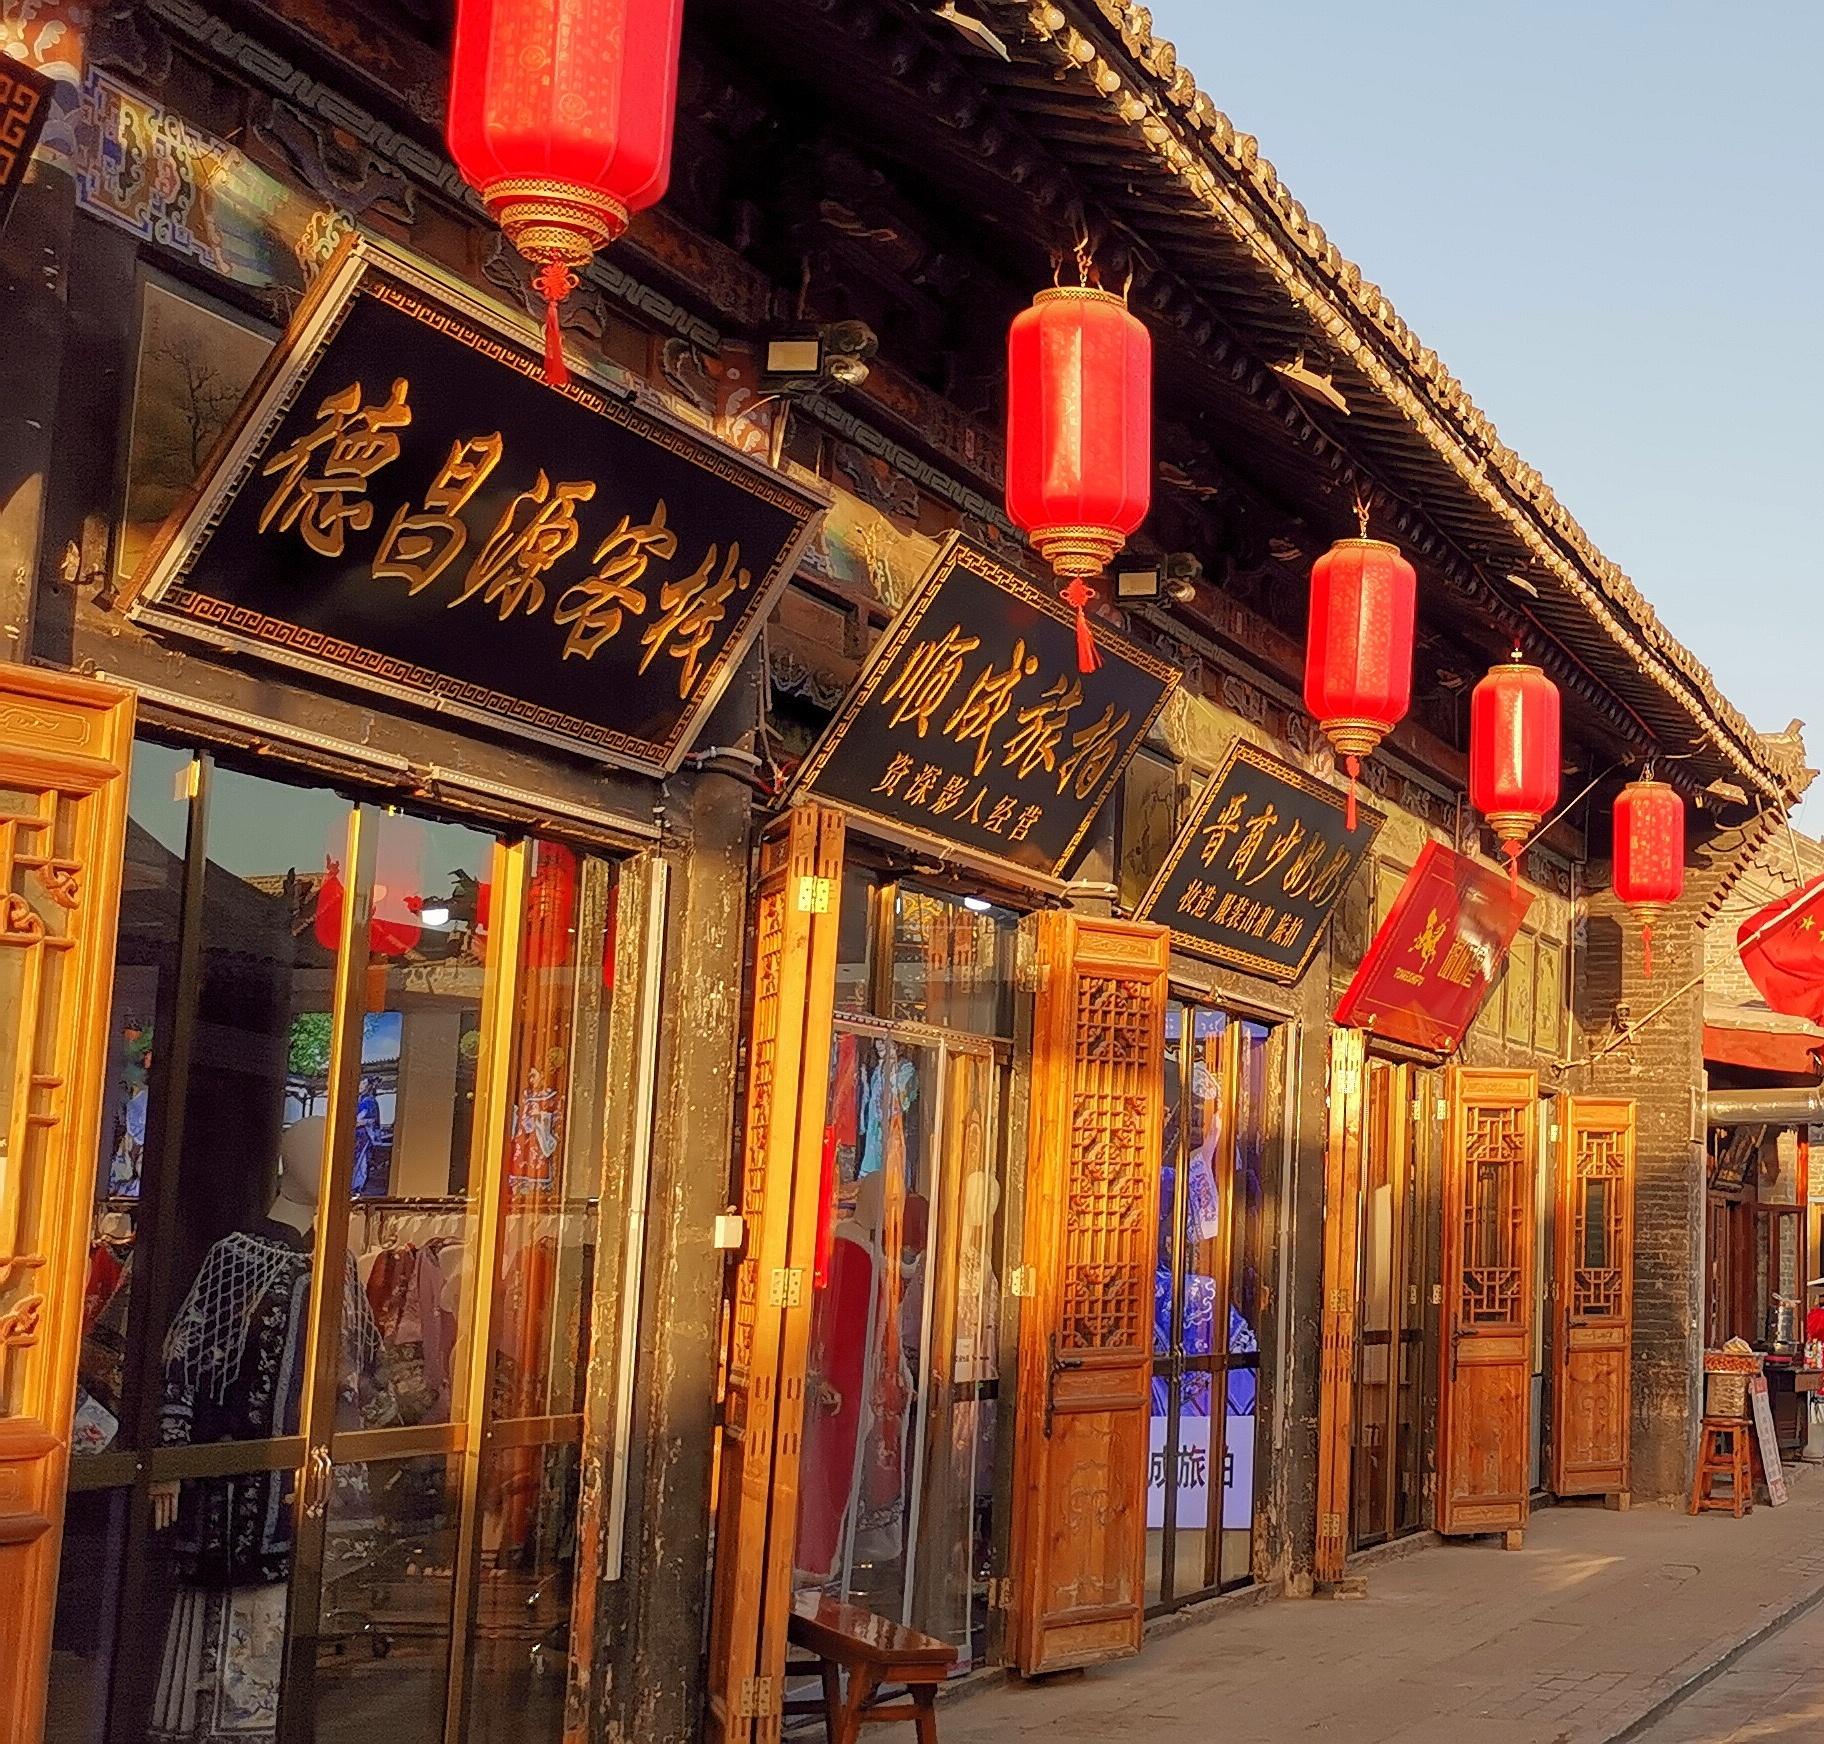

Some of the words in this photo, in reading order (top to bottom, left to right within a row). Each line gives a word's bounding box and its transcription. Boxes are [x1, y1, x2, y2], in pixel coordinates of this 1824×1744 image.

[882, 623, 1131, 801] 顺成旅拍
[870, 750, 1044, 843] 资深影人经营
[1202, 793, 1352, 908] 晋商少奶奶
